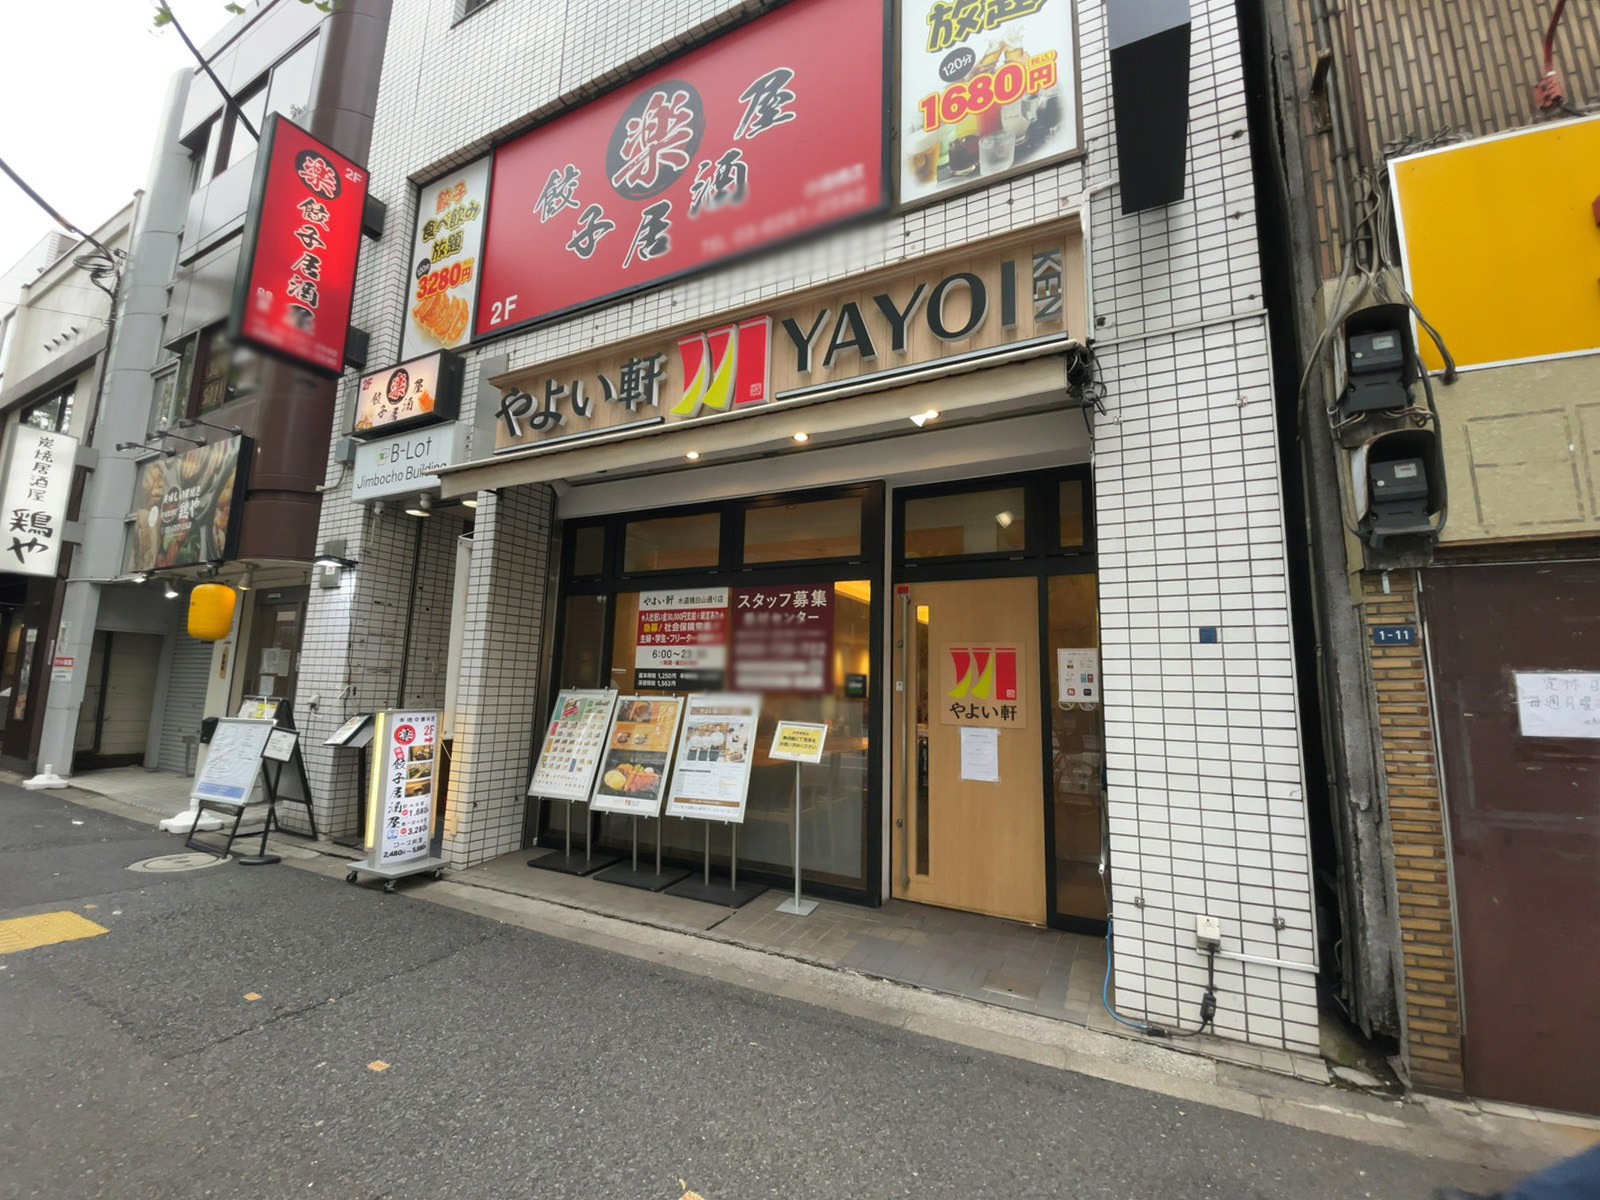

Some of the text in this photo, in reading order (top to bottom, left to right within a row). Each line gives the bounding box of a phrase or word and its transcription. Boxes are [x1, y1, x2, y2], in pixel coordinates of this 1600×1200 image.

[943, 54, 972, 77] 120分
[920, 62, 1057, 132] 1680円
[344, 167, 362, 183] 2F
[421, 199, 481, 243] 食べ飲み
[431, 228, 465, 263] 放題
[416, 261, 472, 299] 3280円
[490, 294, 518, 325] 2F
[782, 249, 1063, 374] YAYOI KEN
[362, 377, 373, 391] 2F
[495, 352, 667, 437] やよい軒
[390, 436, 432, 463] B-Lot
[27, 436, 54, 503] 炭焼居酒屋
[357, 471, 404, 490] Jimbocho
[7, 508, 53, 564] 鶏や
[643, 594, 675, 606] やよい軒
[738, 589, 827, 609] スタッフ募集
[1379, 630, 1409, 641] 1-11
[949, 702, 1017, 721] やよい軒
[424, 725, 434, 736] 2F
